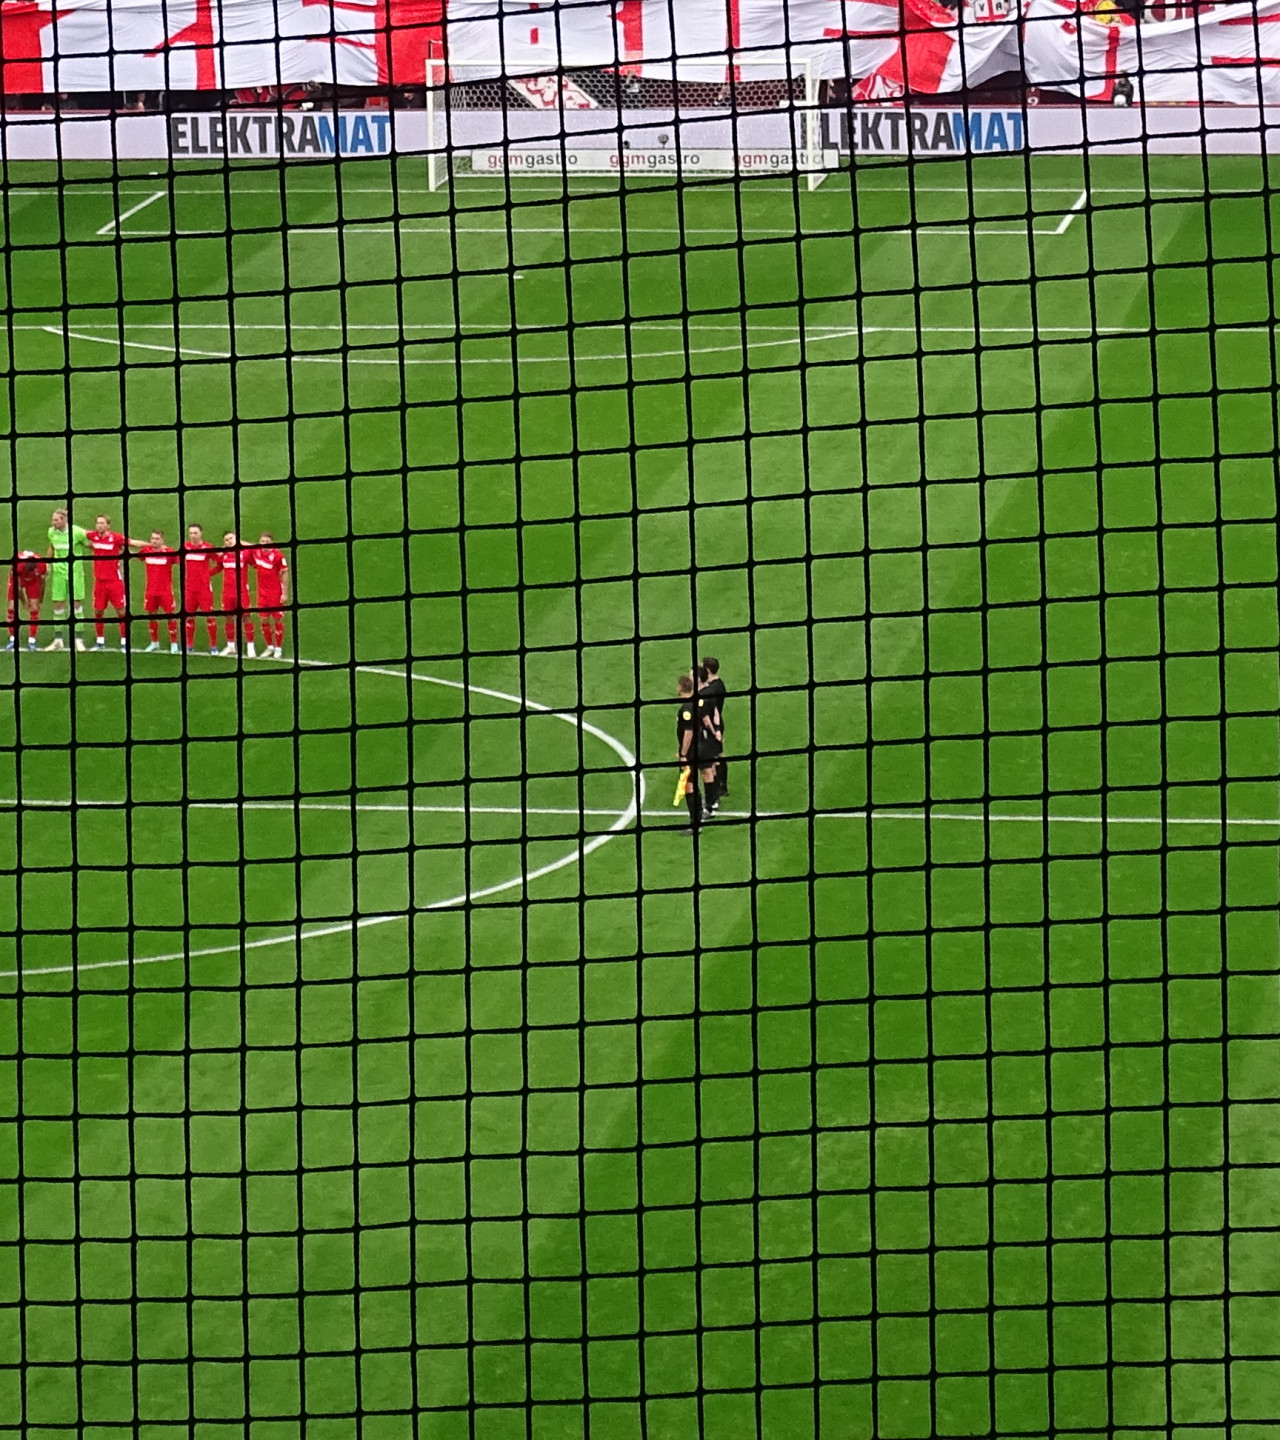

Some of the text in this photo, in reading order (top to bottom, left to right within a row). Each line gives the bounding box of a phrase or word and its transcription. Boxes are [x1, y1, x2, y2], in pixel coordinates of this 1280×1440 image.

[171, 115, 391, 154] ELEKTRAMAT
[487, 152, 578, 169] ggmgasto
[609, 151, 700, 168] ggmgasro
[732, 151, 821, 168] gmgato
